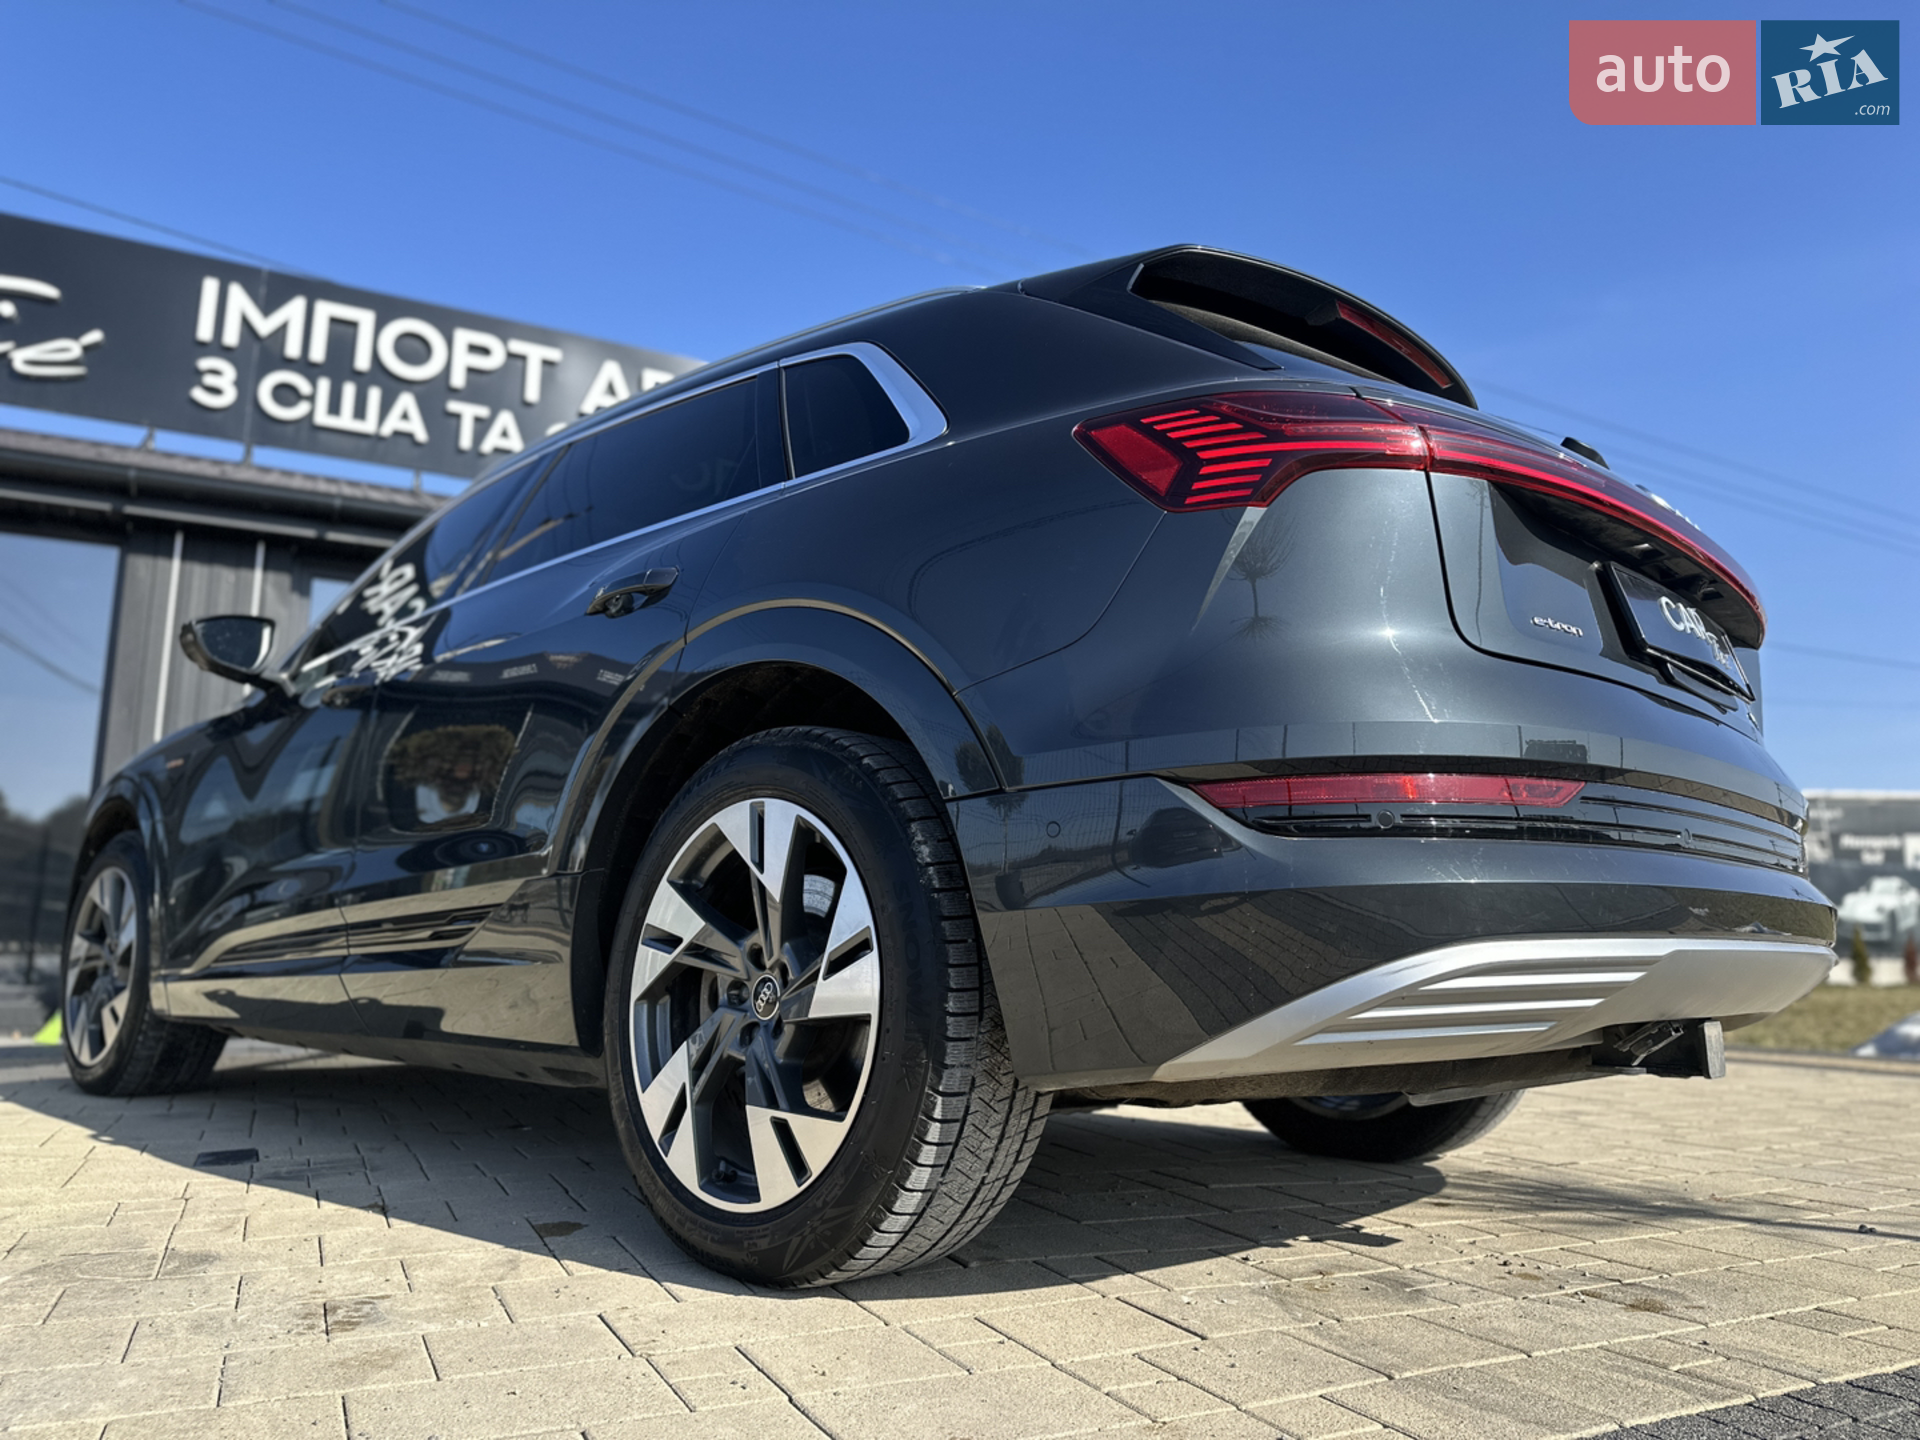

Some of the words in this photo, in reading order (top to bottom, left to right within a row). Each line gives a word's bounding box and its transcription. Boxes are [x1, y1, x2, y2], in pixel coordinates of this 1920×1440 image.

[194, 276, 563, 405] ІМПОРТ
[256, 369, 429, 445] США
[445, 398, 526, 455] ТА
[1532, 615, 1584, 638] e-tron
